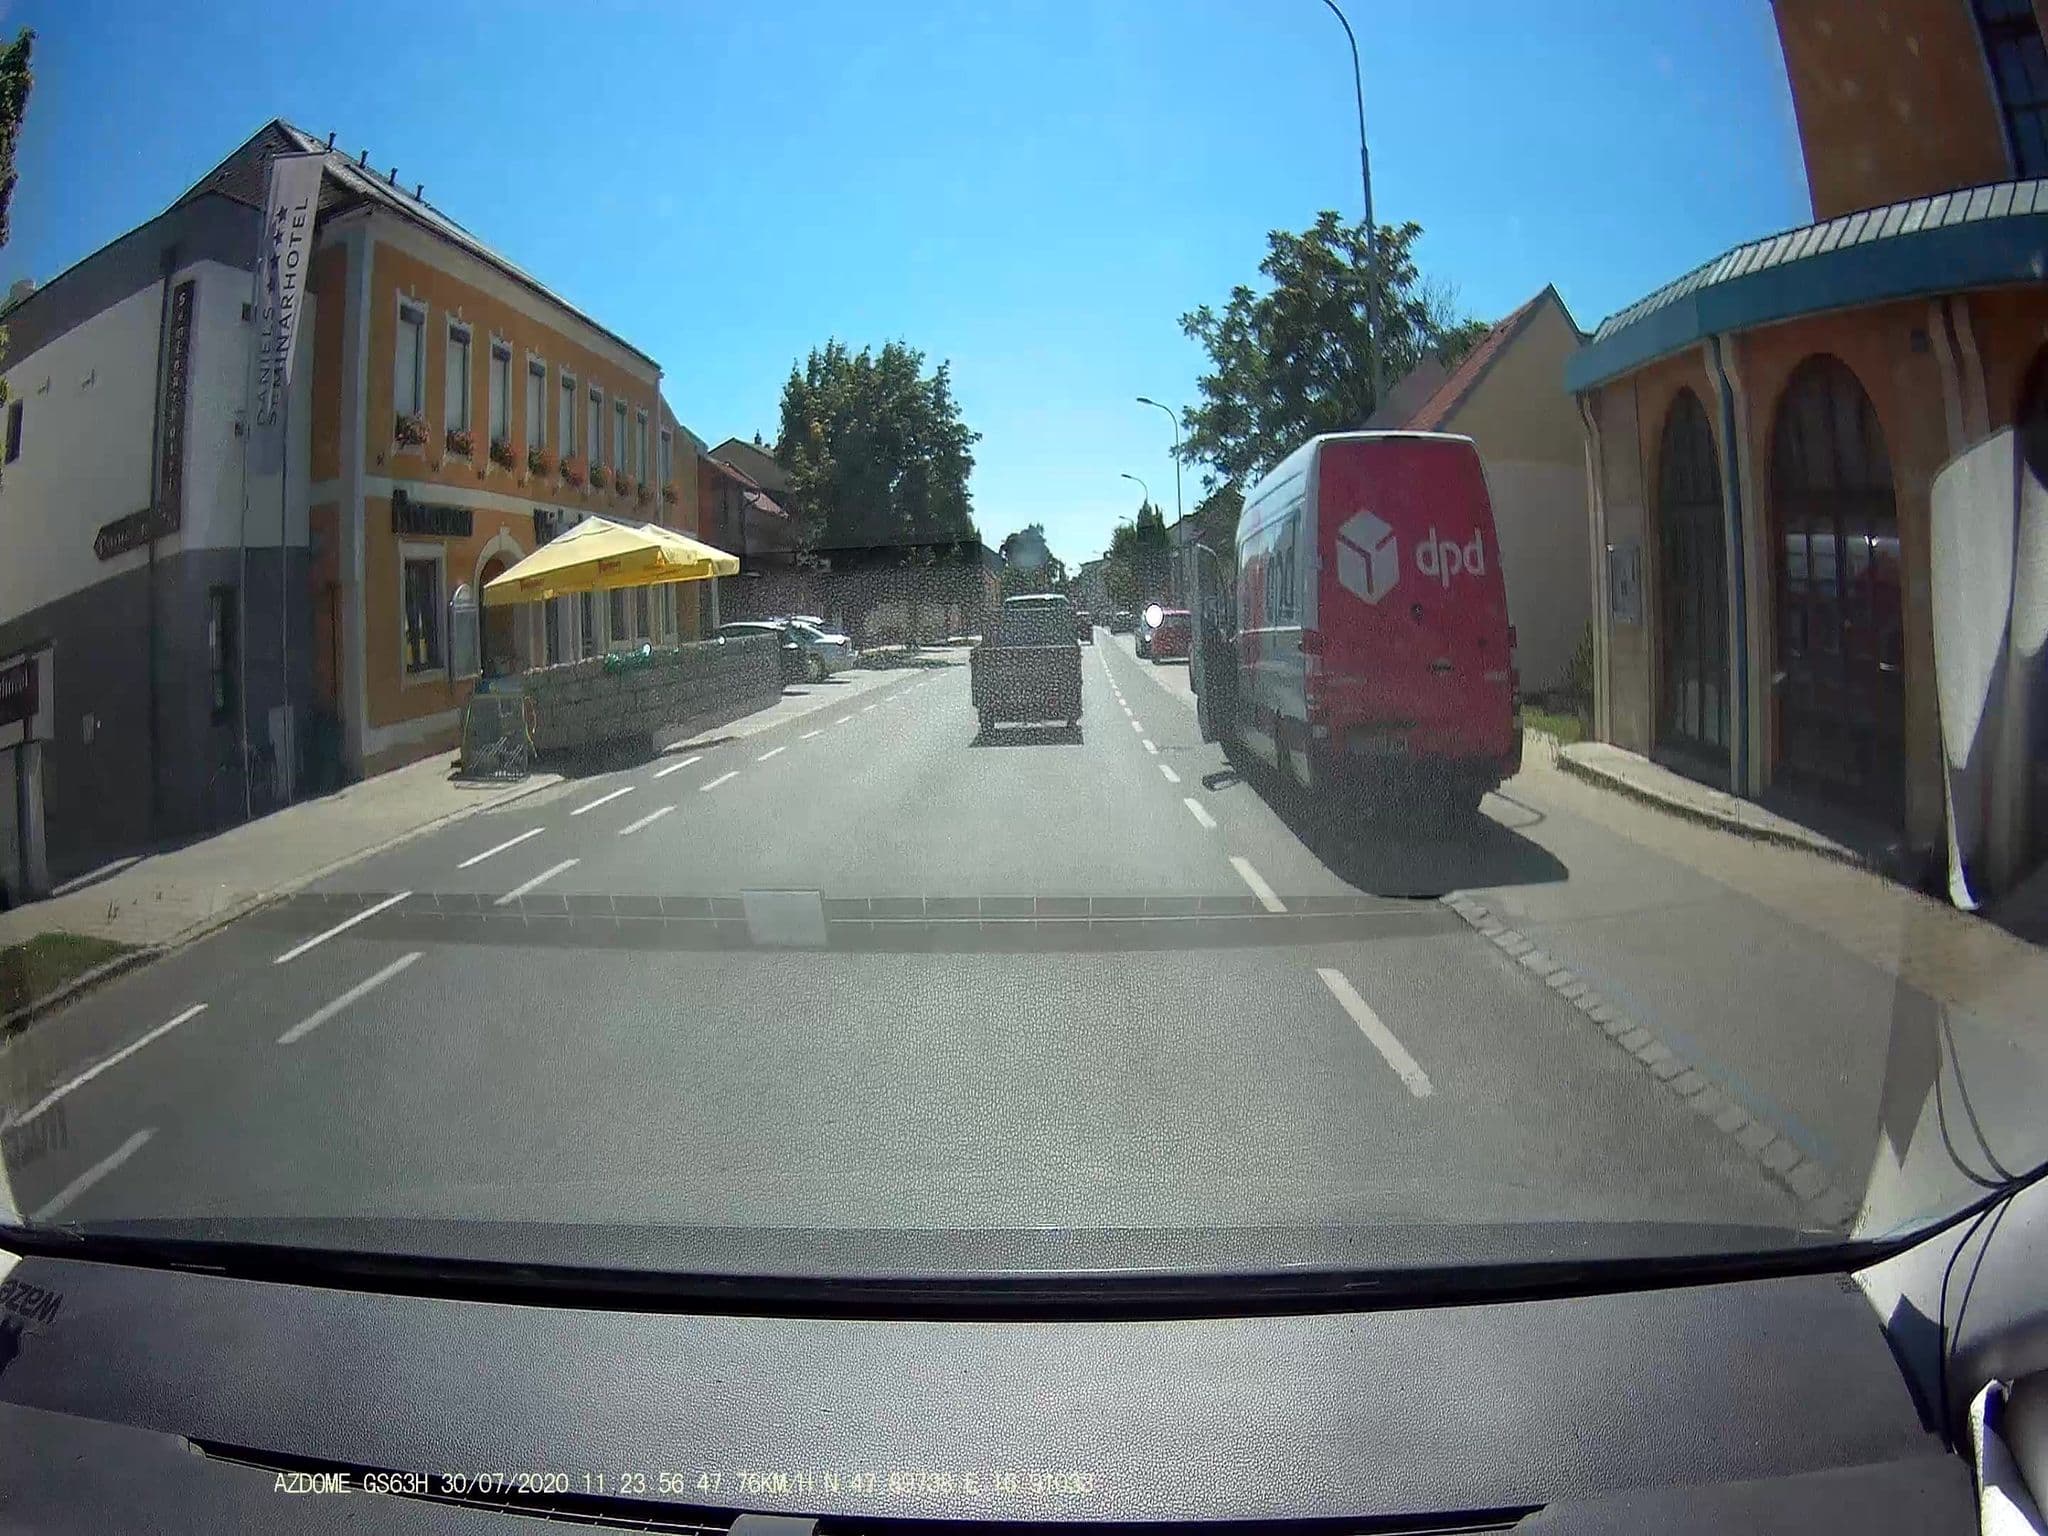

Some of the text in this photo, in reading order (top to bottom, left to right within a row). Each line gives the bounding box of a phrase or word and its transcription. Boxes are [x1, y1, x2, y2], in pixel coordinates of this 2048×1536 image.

[256, 305, 275, 427] DANIELS
[266, 197, 309, 426] SEMINARHOTEL
[1415, 526, 1486, 590] dpd
